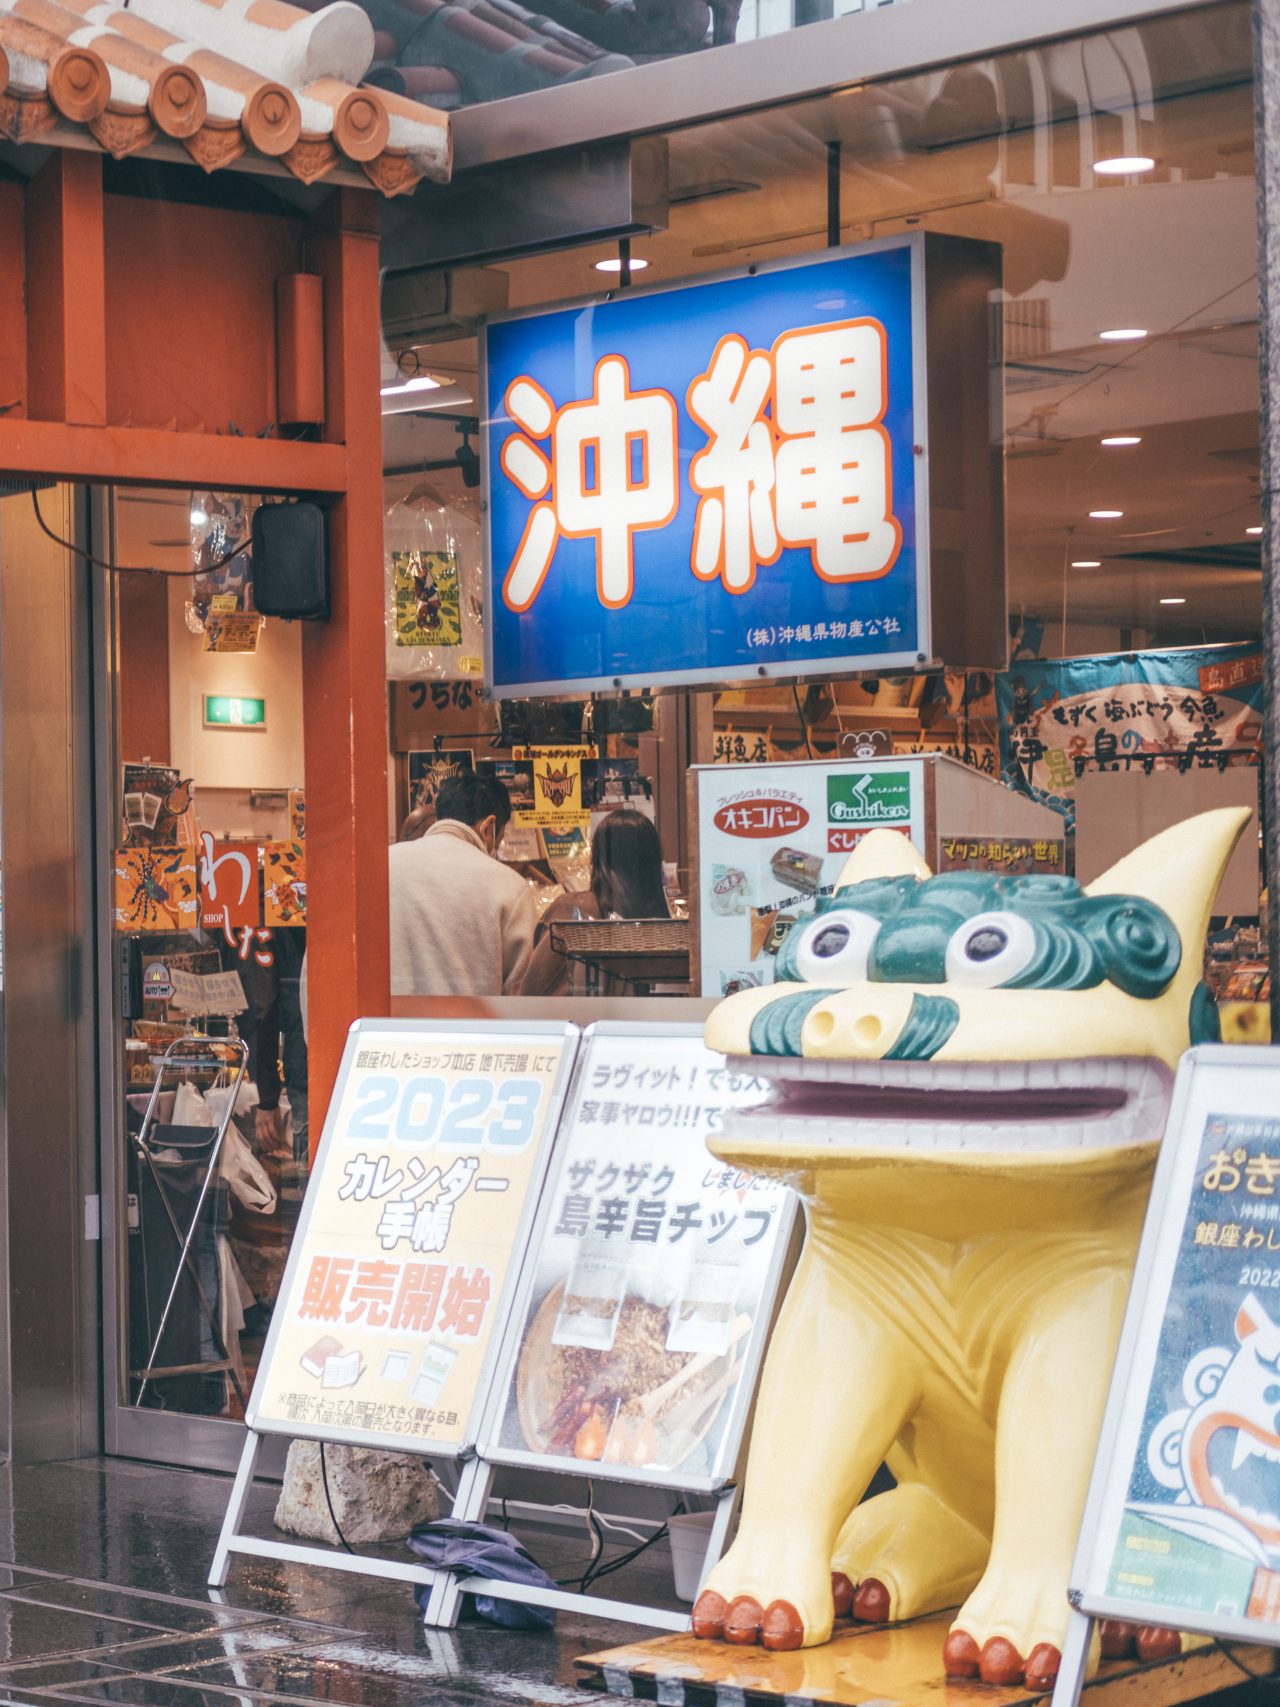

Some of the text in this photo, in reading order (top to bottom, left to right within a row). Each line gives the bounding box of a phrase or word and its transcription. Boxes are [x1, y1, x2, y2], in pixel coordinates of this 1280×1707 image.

[500, 316, 902, 613] 沖縄
[1052, 703, 1098, 727] もずく
[722, 806, 800, 830] オキコパン
[942, 840, 1059, 865] マツコの知らない世界
[203, 913, 224, 924] SHOP
[145, 986, 158, 995] AUTO
[345, 1076, 544, 1148] 2023
[338, 1155, 510, 1202] カレンダー
[567, 1159, 676, 1197] ザクザク
[1202, 1147, 1280, 1195] おき
[376, 1201, 454, 1253] 手帳
[554, 1193, 778, 1247] 島辛旨チップ
[1194, 1221, 1280, 1250] 銀座わし
[297, 1255, 492, 1335] 販売開始
